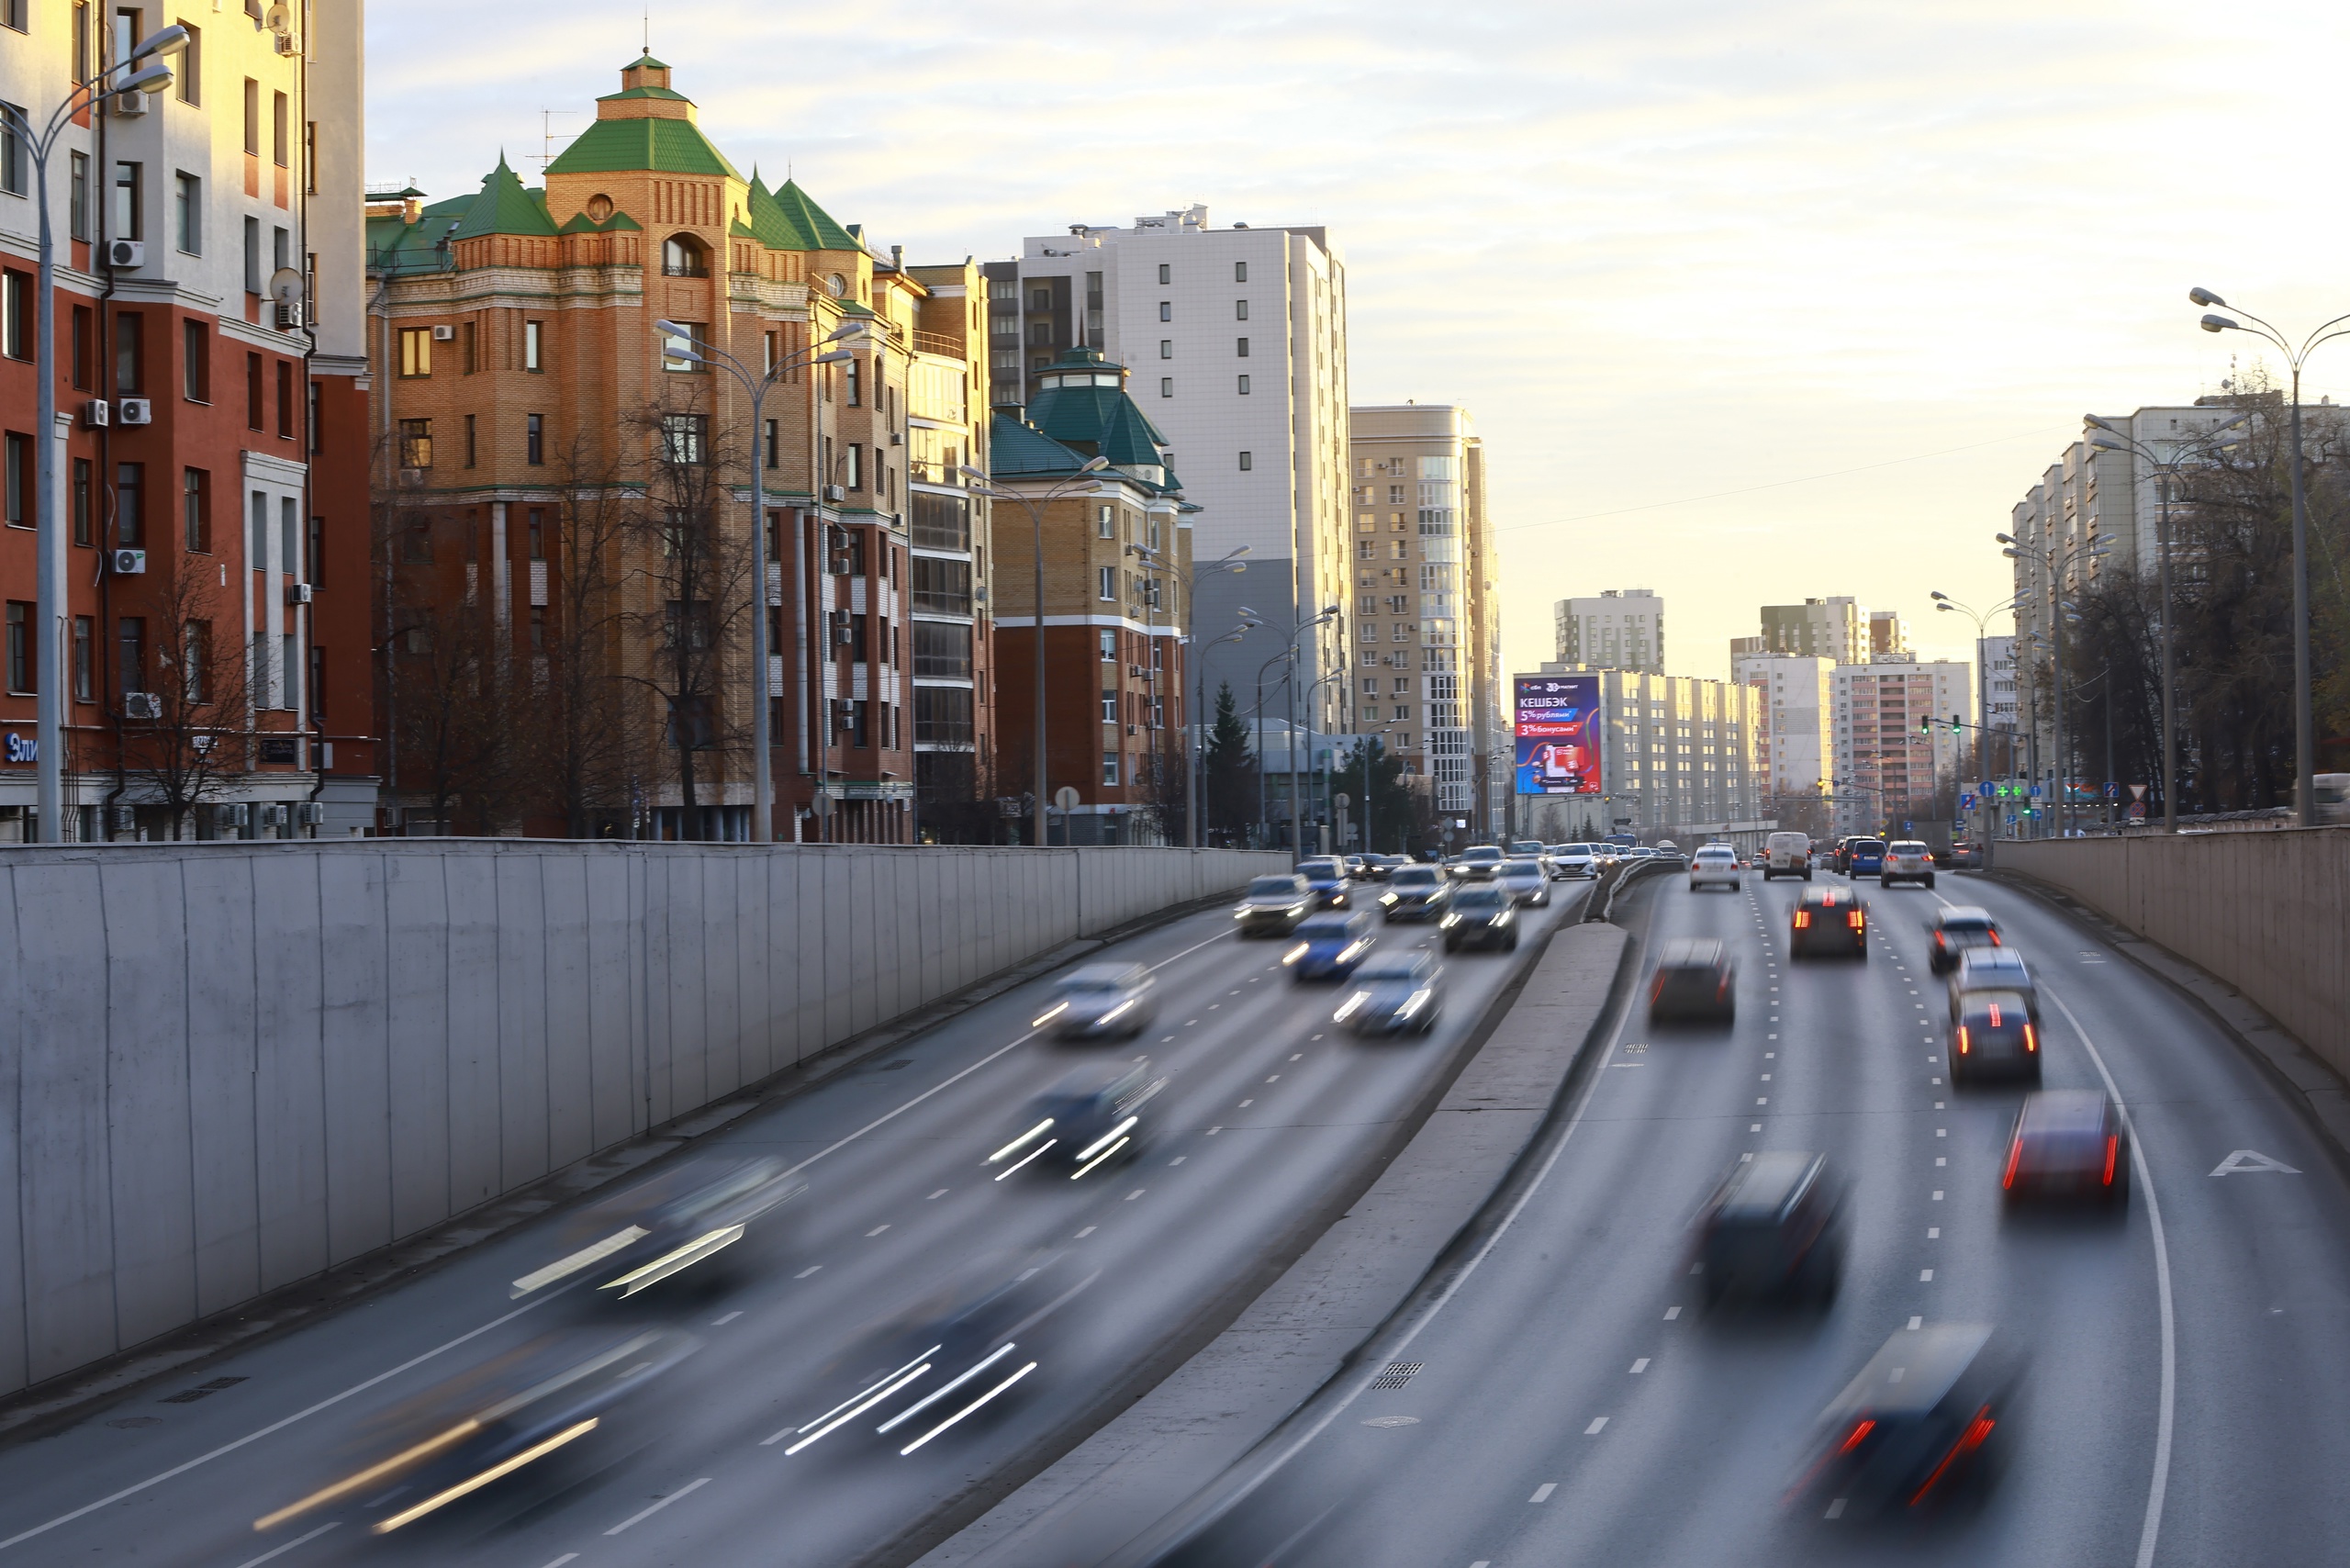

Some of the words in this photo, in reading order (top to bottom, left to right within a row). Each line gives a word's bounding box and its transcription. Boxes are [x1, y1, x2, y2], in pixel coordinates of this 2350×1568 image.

[1520, 697, 1568, 707] КЕШБЭК
[1520, 711, 1536, 721] 5%
[1521, 724, 1537, 735] 3%
